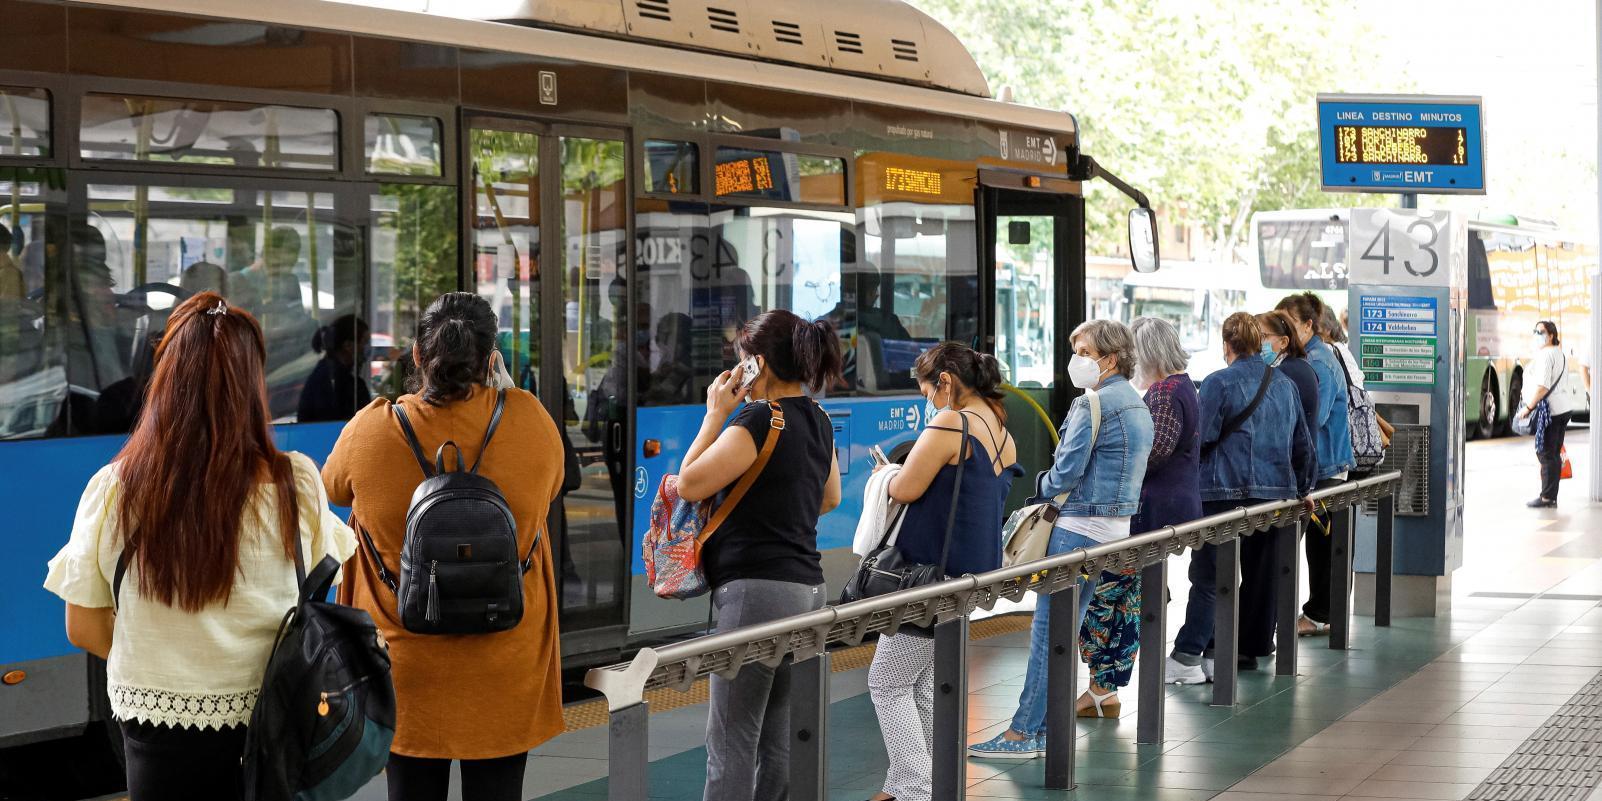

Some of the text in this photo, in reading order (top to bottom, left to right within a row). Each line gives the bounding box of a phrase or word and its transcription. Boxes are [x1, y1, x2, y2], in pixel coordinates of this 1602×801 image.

[1337, 112, 1462, 122] LINEA DESTINO MINUTOS
[1338, 127, 1356, 137] 173
[1361, 127, 1427, 138] SANCHINARRO
[1026, 136, 1041, 148] EMT
[1362, 136, 1415, 146] HORTALEZA
[1014, 148, 1041, 162] MADRID
[1339, 145, 1357, 154] 174
[1340, 153, 1464, 165] 173 SANCHINARRO 11
[1404, 171, 1434, 183] EMT
[1360, 218, 1439, 278] 43
[1367, 310, 1383, 318] 173
[890, 407, 904, 418] EMT
[878, 420, 904, 431] MADRID
